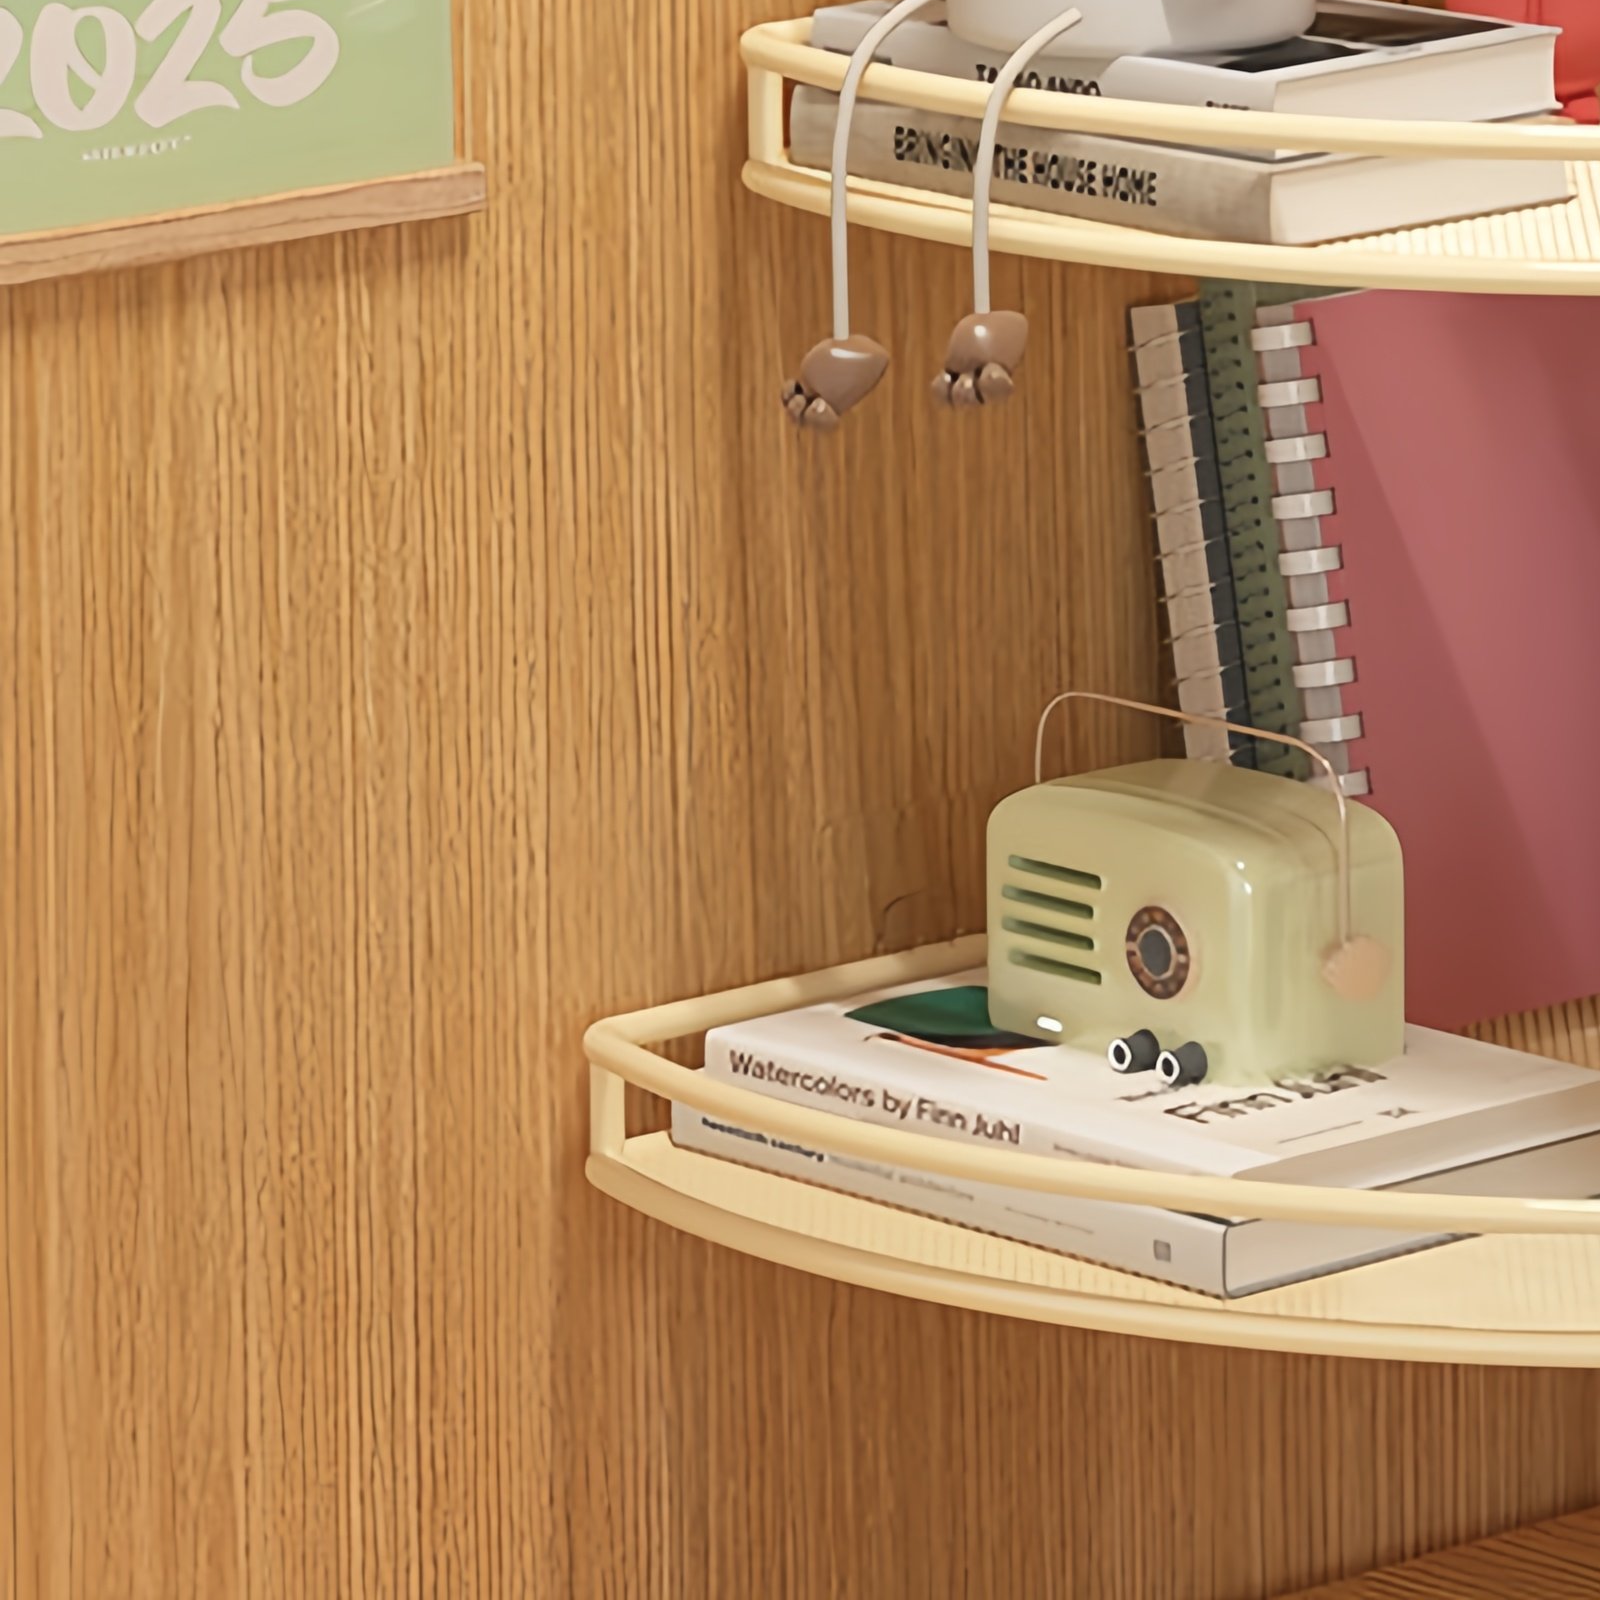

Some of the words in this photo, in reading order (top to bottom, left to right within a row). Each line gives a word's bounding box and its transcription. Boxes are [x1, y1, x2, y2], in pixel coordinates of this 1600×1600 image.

[1101, 164, 1158, 207] HOME
[729, 1049, 876, 1108] Watercolors
[882, 1088, 912, 1121] by
[971, 1112, 1021, 1146] Juhl
